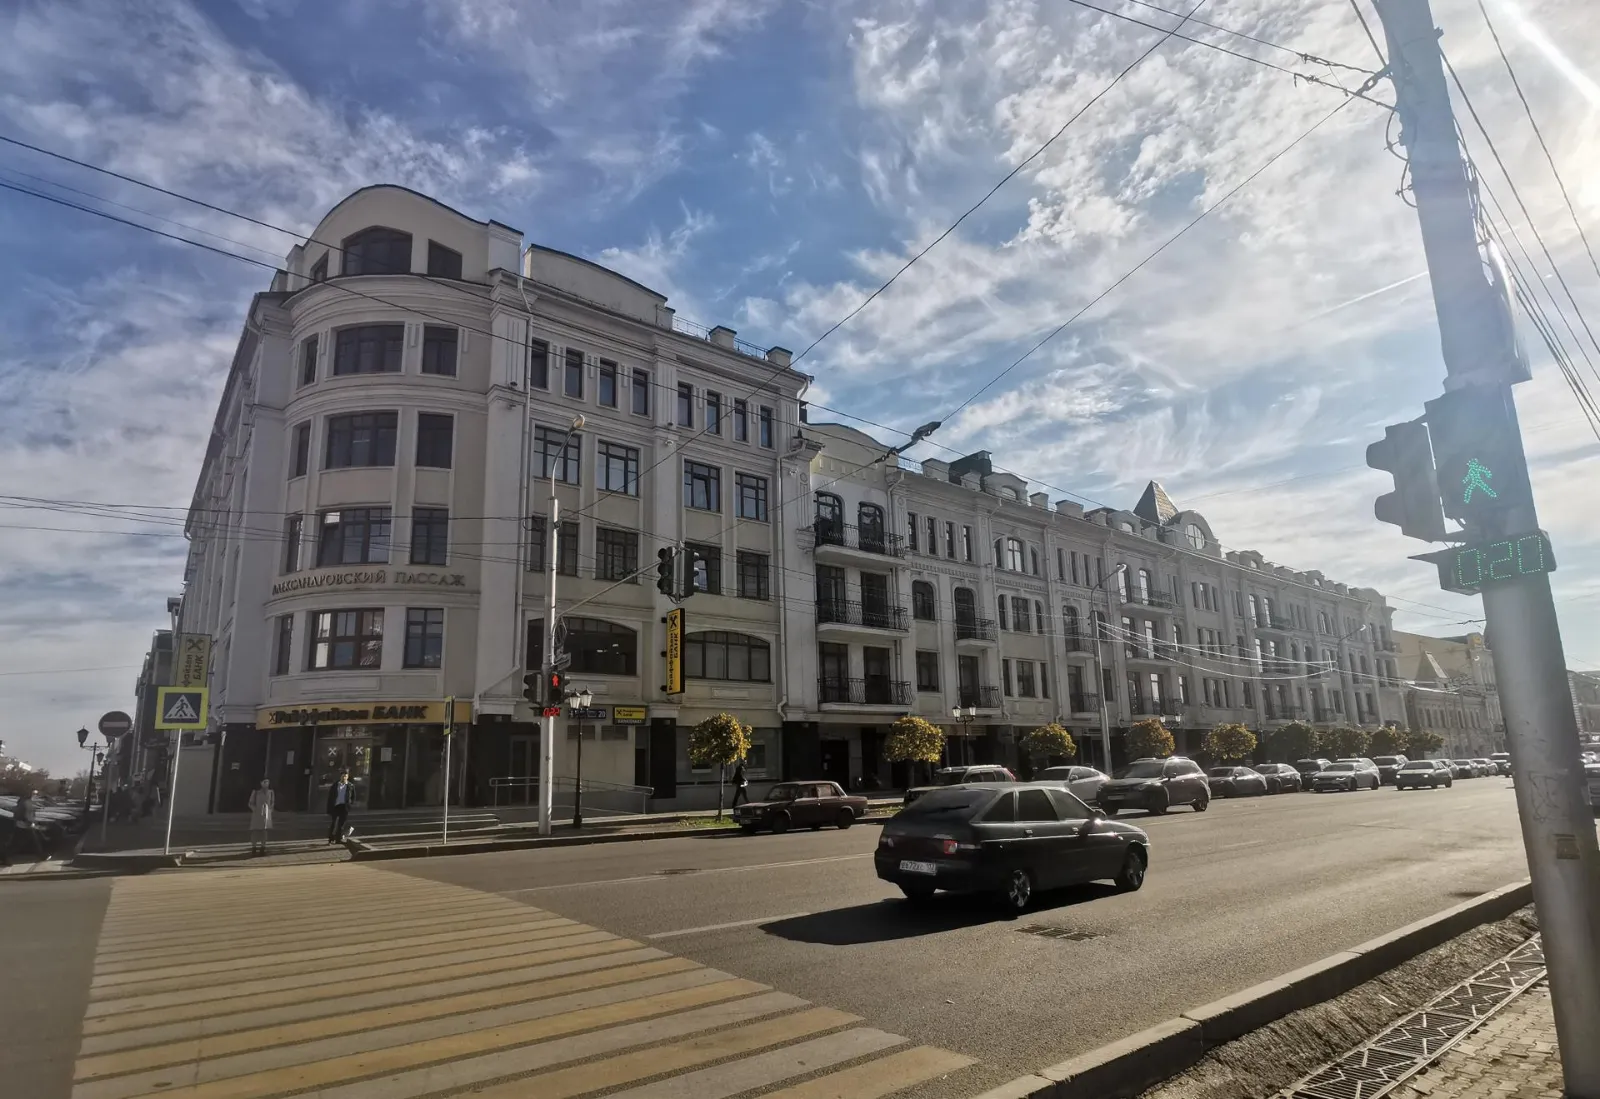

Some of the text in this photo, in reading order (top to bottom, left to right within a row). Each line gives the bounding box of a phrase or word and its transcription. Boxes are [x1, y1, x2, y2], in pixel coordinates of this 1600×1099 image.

[394, 571, 465, 587] ПАССАЖ
[193, 654, 204, 681] БАНК
[372, 705, 429, 720] БАНК
